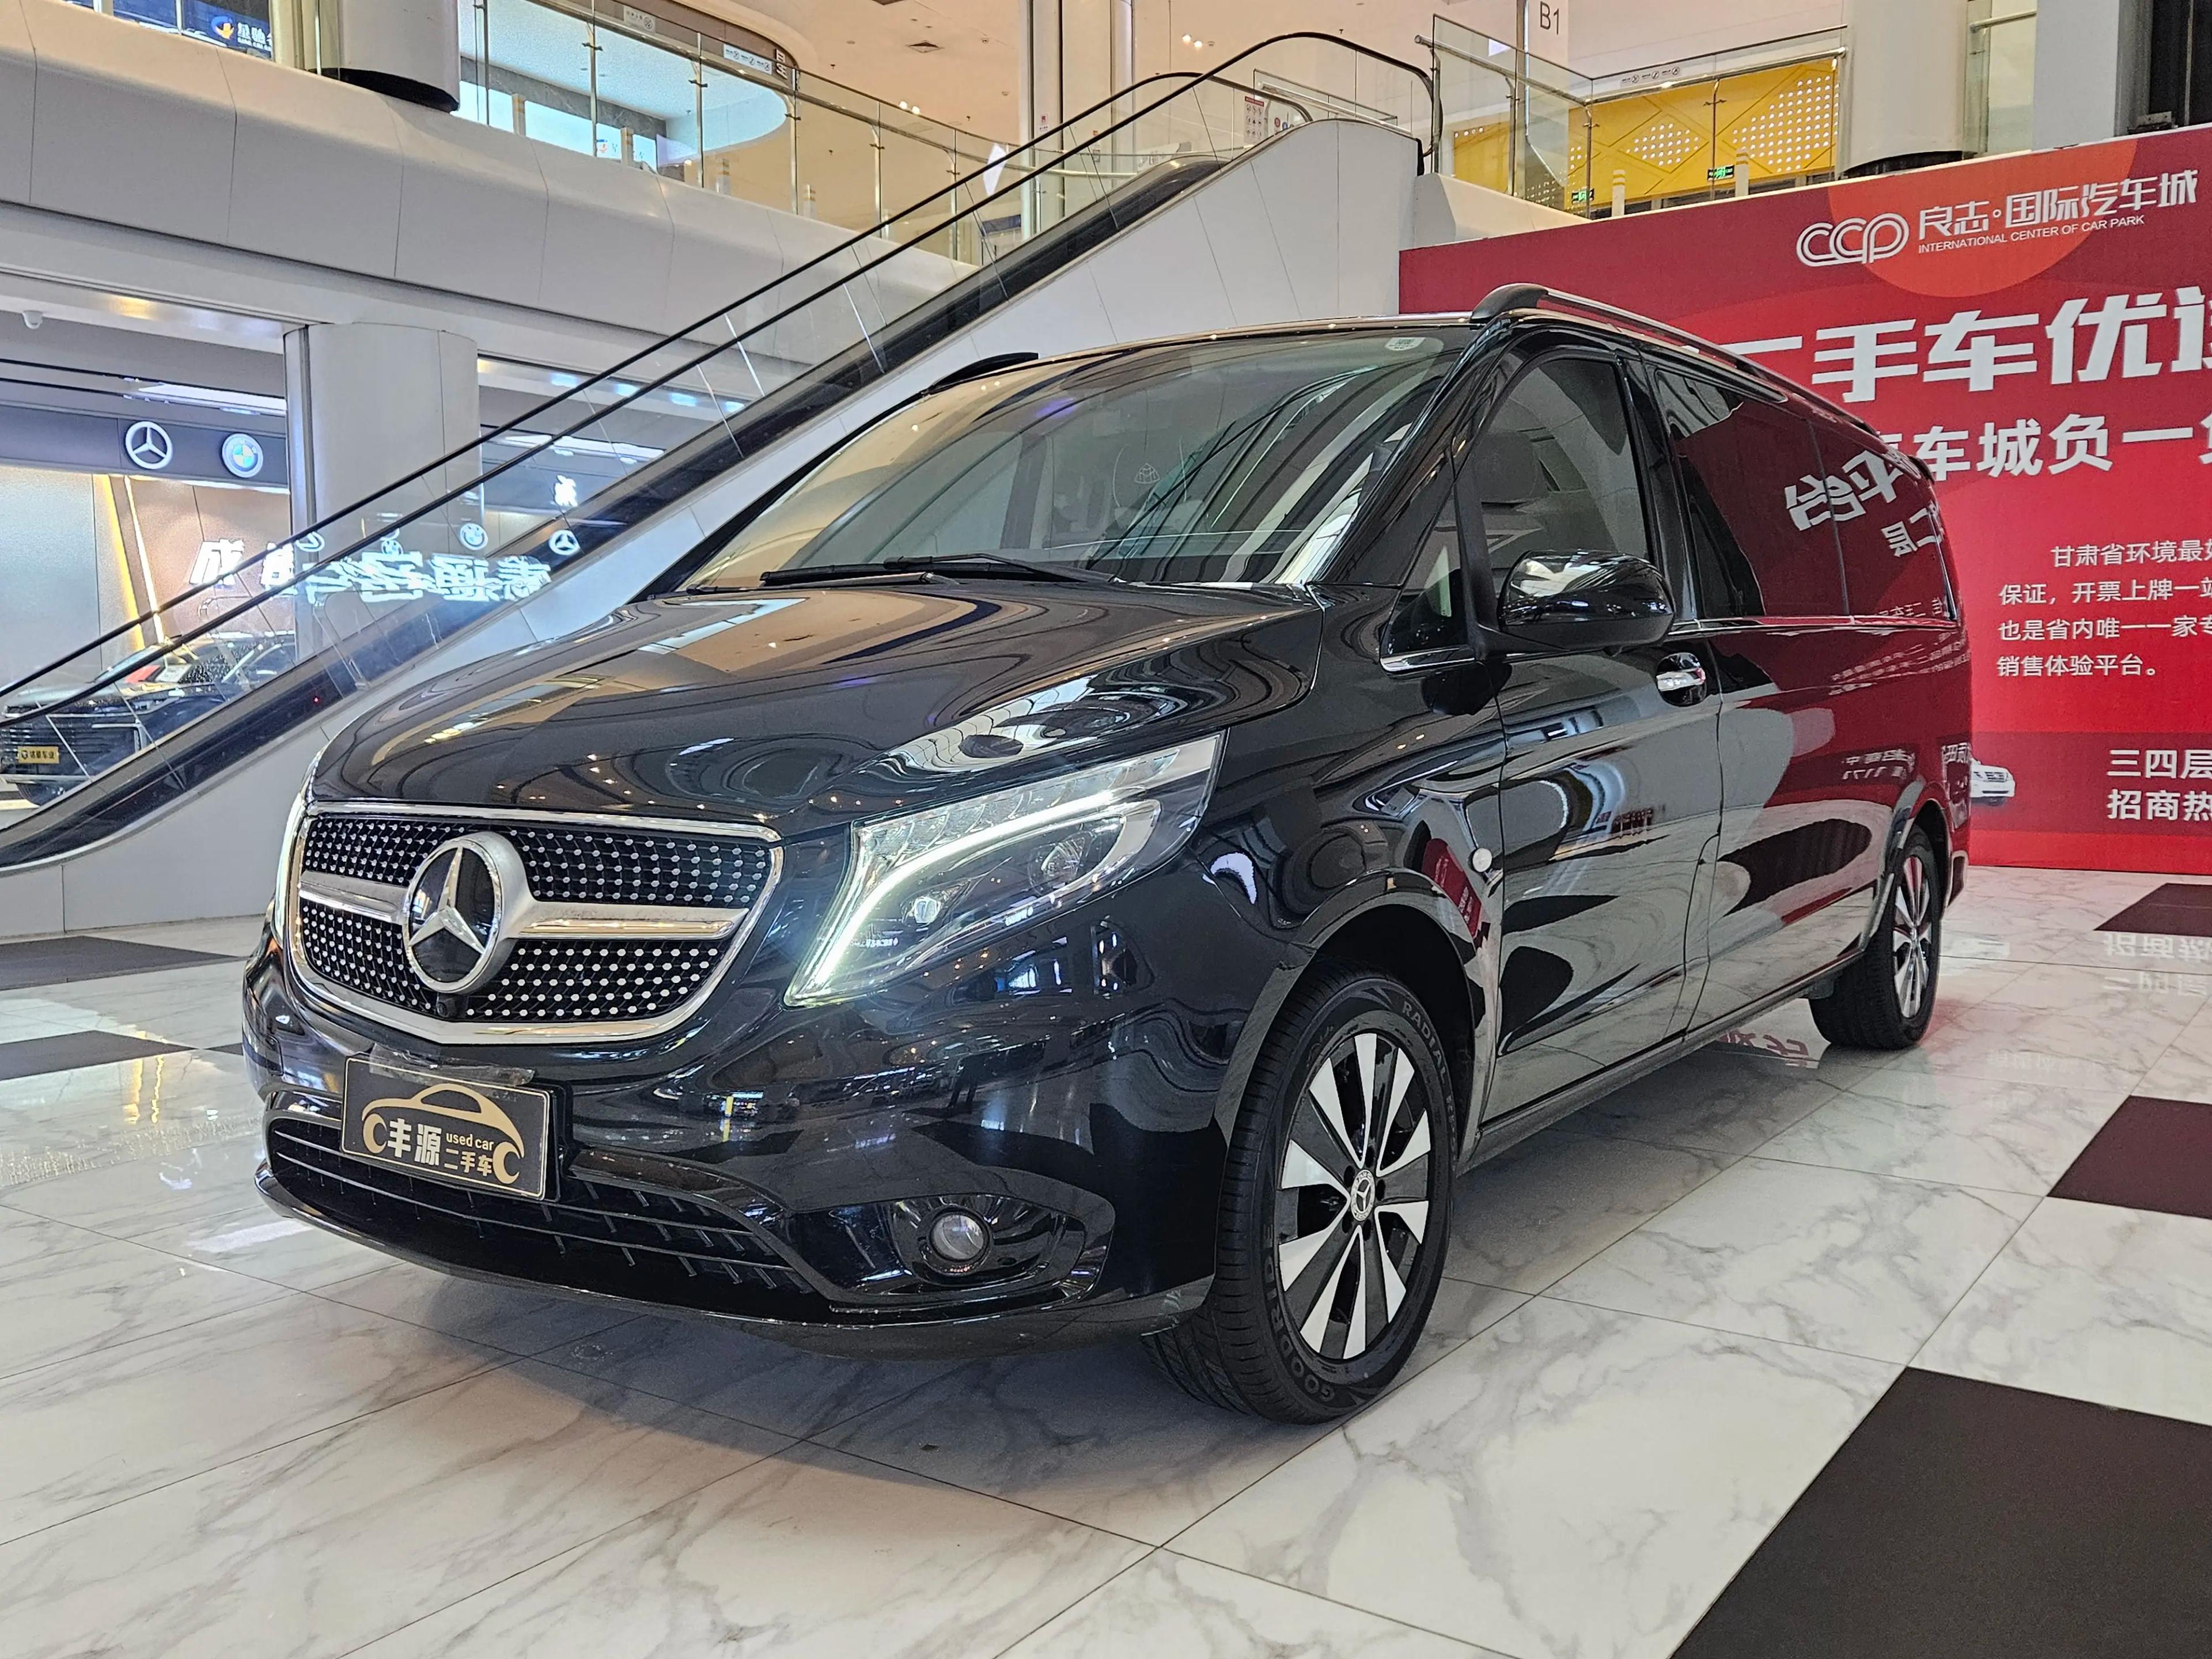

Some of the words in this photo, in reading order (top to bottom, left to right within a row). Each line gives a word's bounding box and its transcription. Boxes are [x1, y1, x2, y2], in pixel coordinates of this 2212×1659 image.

[1540, 1, 1559, 35] B1
[1918, 233, 2008, 253] INTERNATIONAL
[2010, 226, 2059, 242] CENTER
[2062, 224, 2078, 235] OF
[2081, 219, 2107, 232] CAR
[2110, 214, 2145, 228] PARK
[1877, 412, 2212, 482] 车城负一
[1997, 653, 2157, 677] 销售体验平台。
[2107, 749, 2212, 779] 三四层
[2107, 789, 2212, 821] 招商热
[388, 1118, 442, 1166] 丰源
[446, 1131, 473, 1147] used
[475, 1138, 494, 1151] car
[444, 1149, 493, 1176] 二手车
